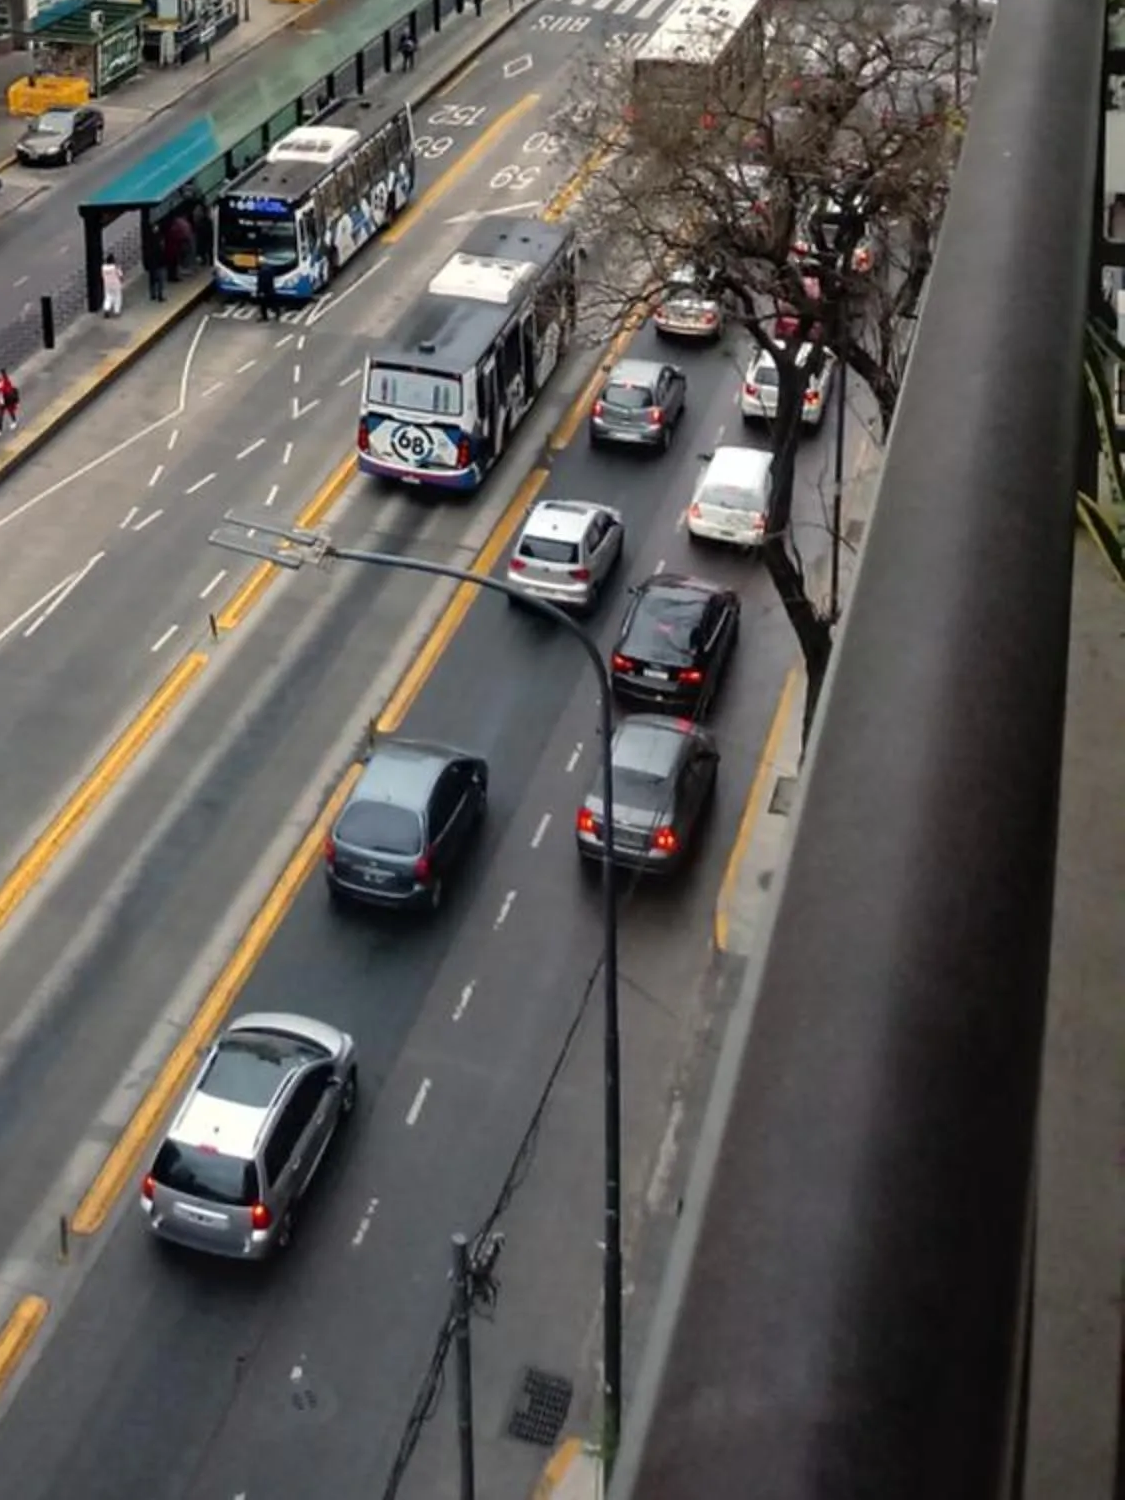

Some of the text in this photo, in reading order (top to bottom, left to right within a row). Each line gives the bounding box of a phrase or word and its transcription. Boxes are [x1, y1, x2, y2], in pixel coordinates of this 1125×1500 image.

[530, 15, 592, 33] BUS
[428, 104, 487, 126] 152
[490, 164, 542, 191] 59
[398, 431, 424, 456] 68
